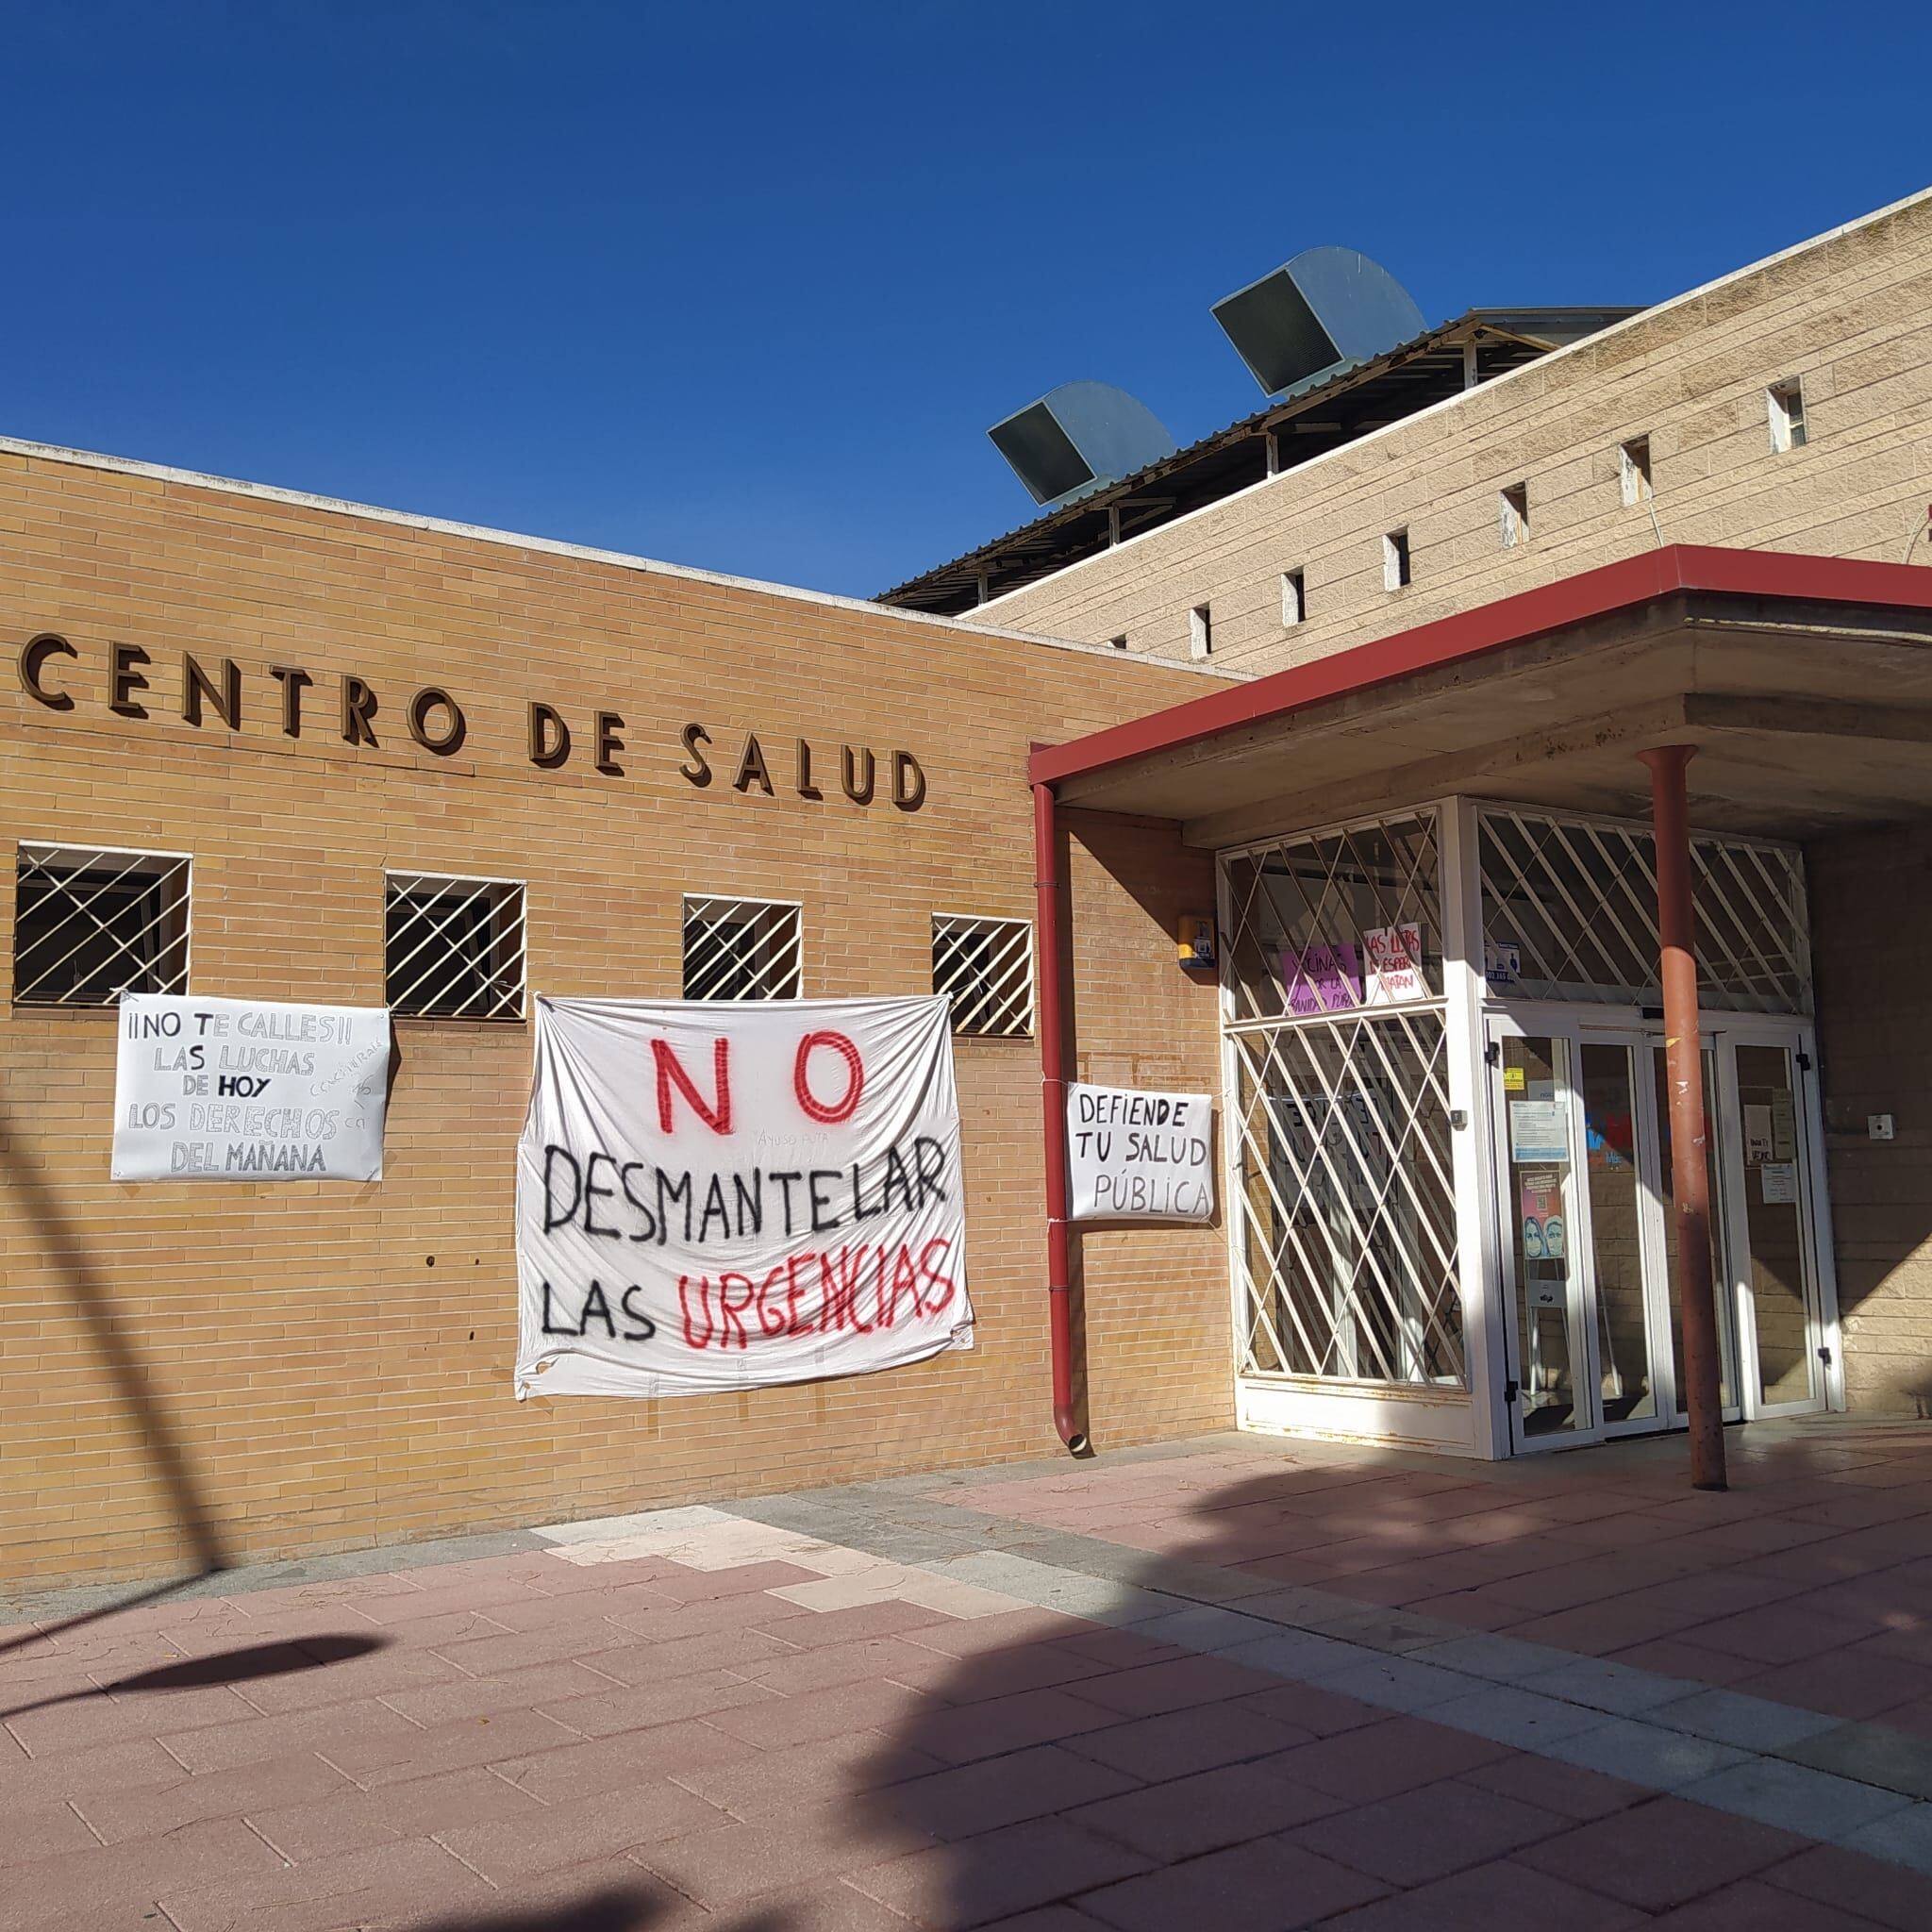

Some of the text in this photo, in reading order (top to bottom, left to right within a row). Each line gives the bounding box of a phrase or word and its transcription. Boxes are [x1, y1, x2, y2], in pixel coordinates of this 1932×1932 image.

[17, 632, 924, 809] CENTRO DE SALUD
[194, 1013, 229, 1037] TE
[238, 1013, 353, 1044] CALLES!!
[154, 1045, 205, 1071] LAS
[219, 1045, 315, 1076] LUCHAS
[182, 1074, 272, 1097] DE HOY
[650, 1030, 864, 1135] NO
[128, 1104, 175, 1130] LOS
[190, 1104, 340, 1140] DERECHOS
[1079, 1093, 1189, 1127] DEFIENDE
[171, 1140, 326, 1172] DEL MAÑANA
[1075, 1131, 1207, 1166] TU SALUD
[542, 1136, 948, 1245] DESMANTELAR
[1094, 1169, 1211, 1215] PÚBLICA
[541, 1239, 956, 1349] LAS URGENCIAS
